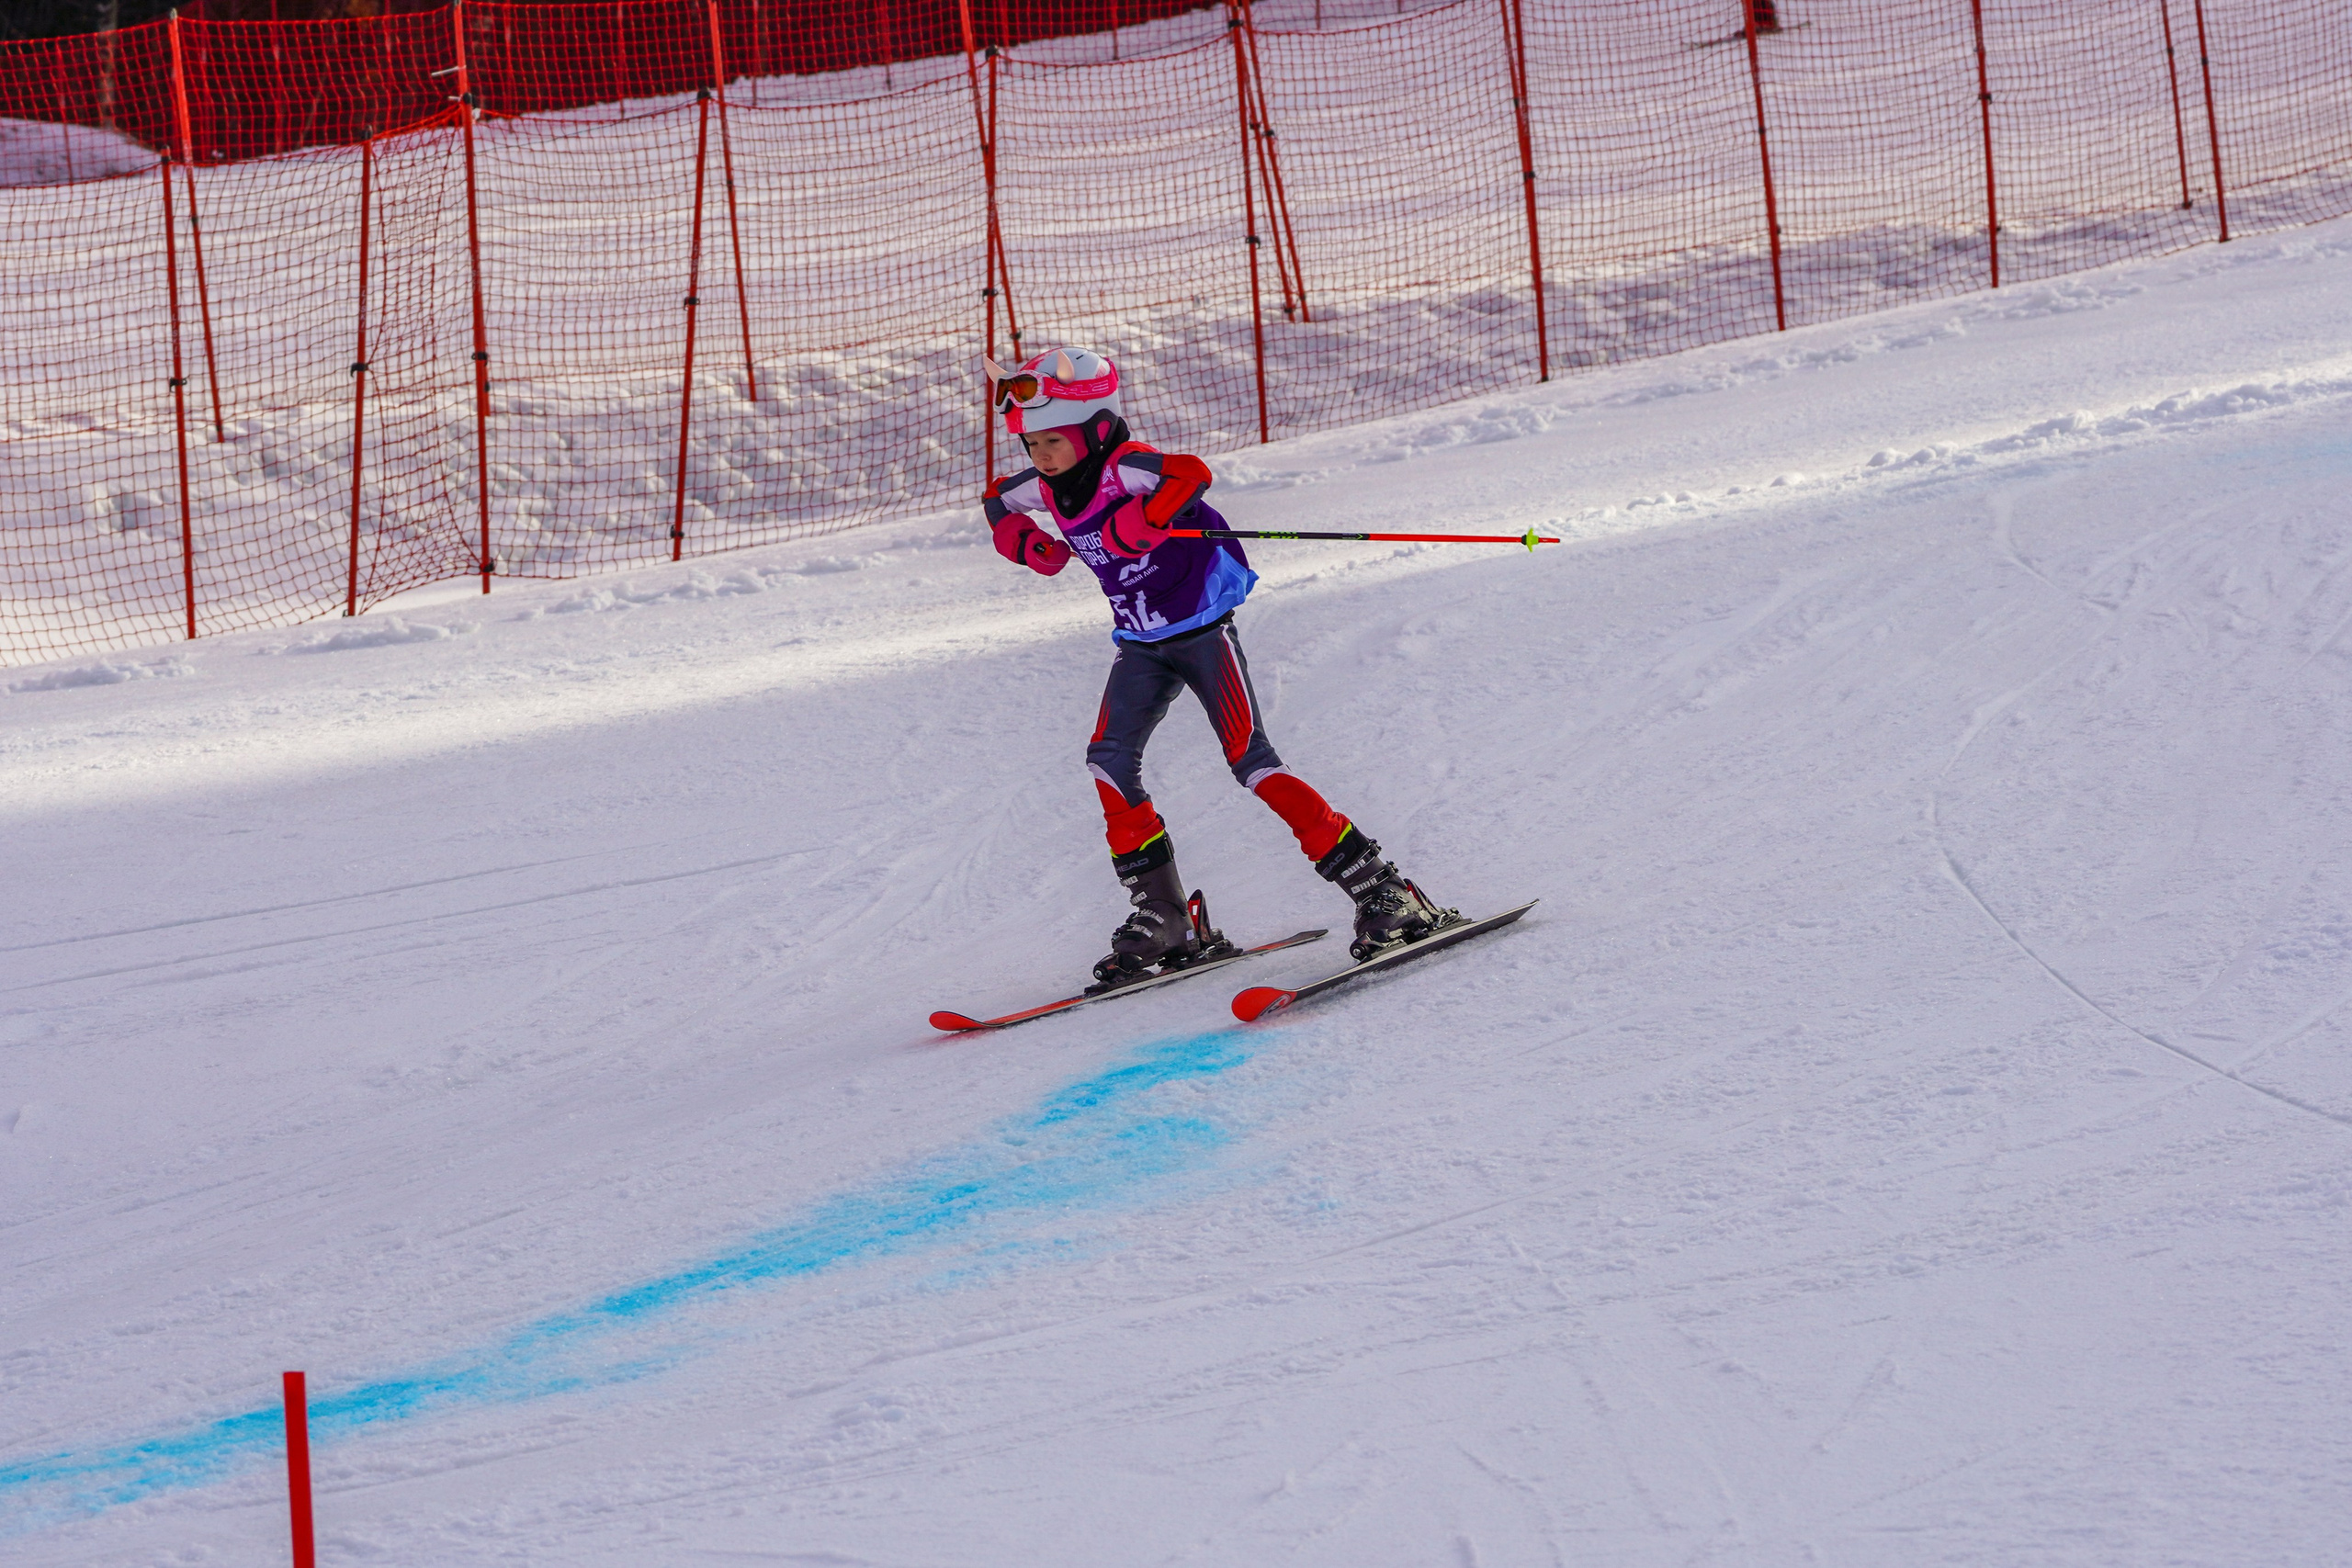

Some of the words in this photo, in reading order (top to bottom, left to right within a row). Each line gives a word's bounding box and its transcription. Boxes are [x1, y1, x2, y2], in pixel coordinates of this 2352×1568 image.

[1069, 530, 1102, 550] ВОРОБ
[1080, 548, 1110, 566] ГОРЫ
[1122, 573, 1144, 588] НОВАЯ
[1143, 564, 1159, 578] ЛИГА
[1109, 590, 1170, 632] 54
[1116, 857, 1149, 873] HEAD
